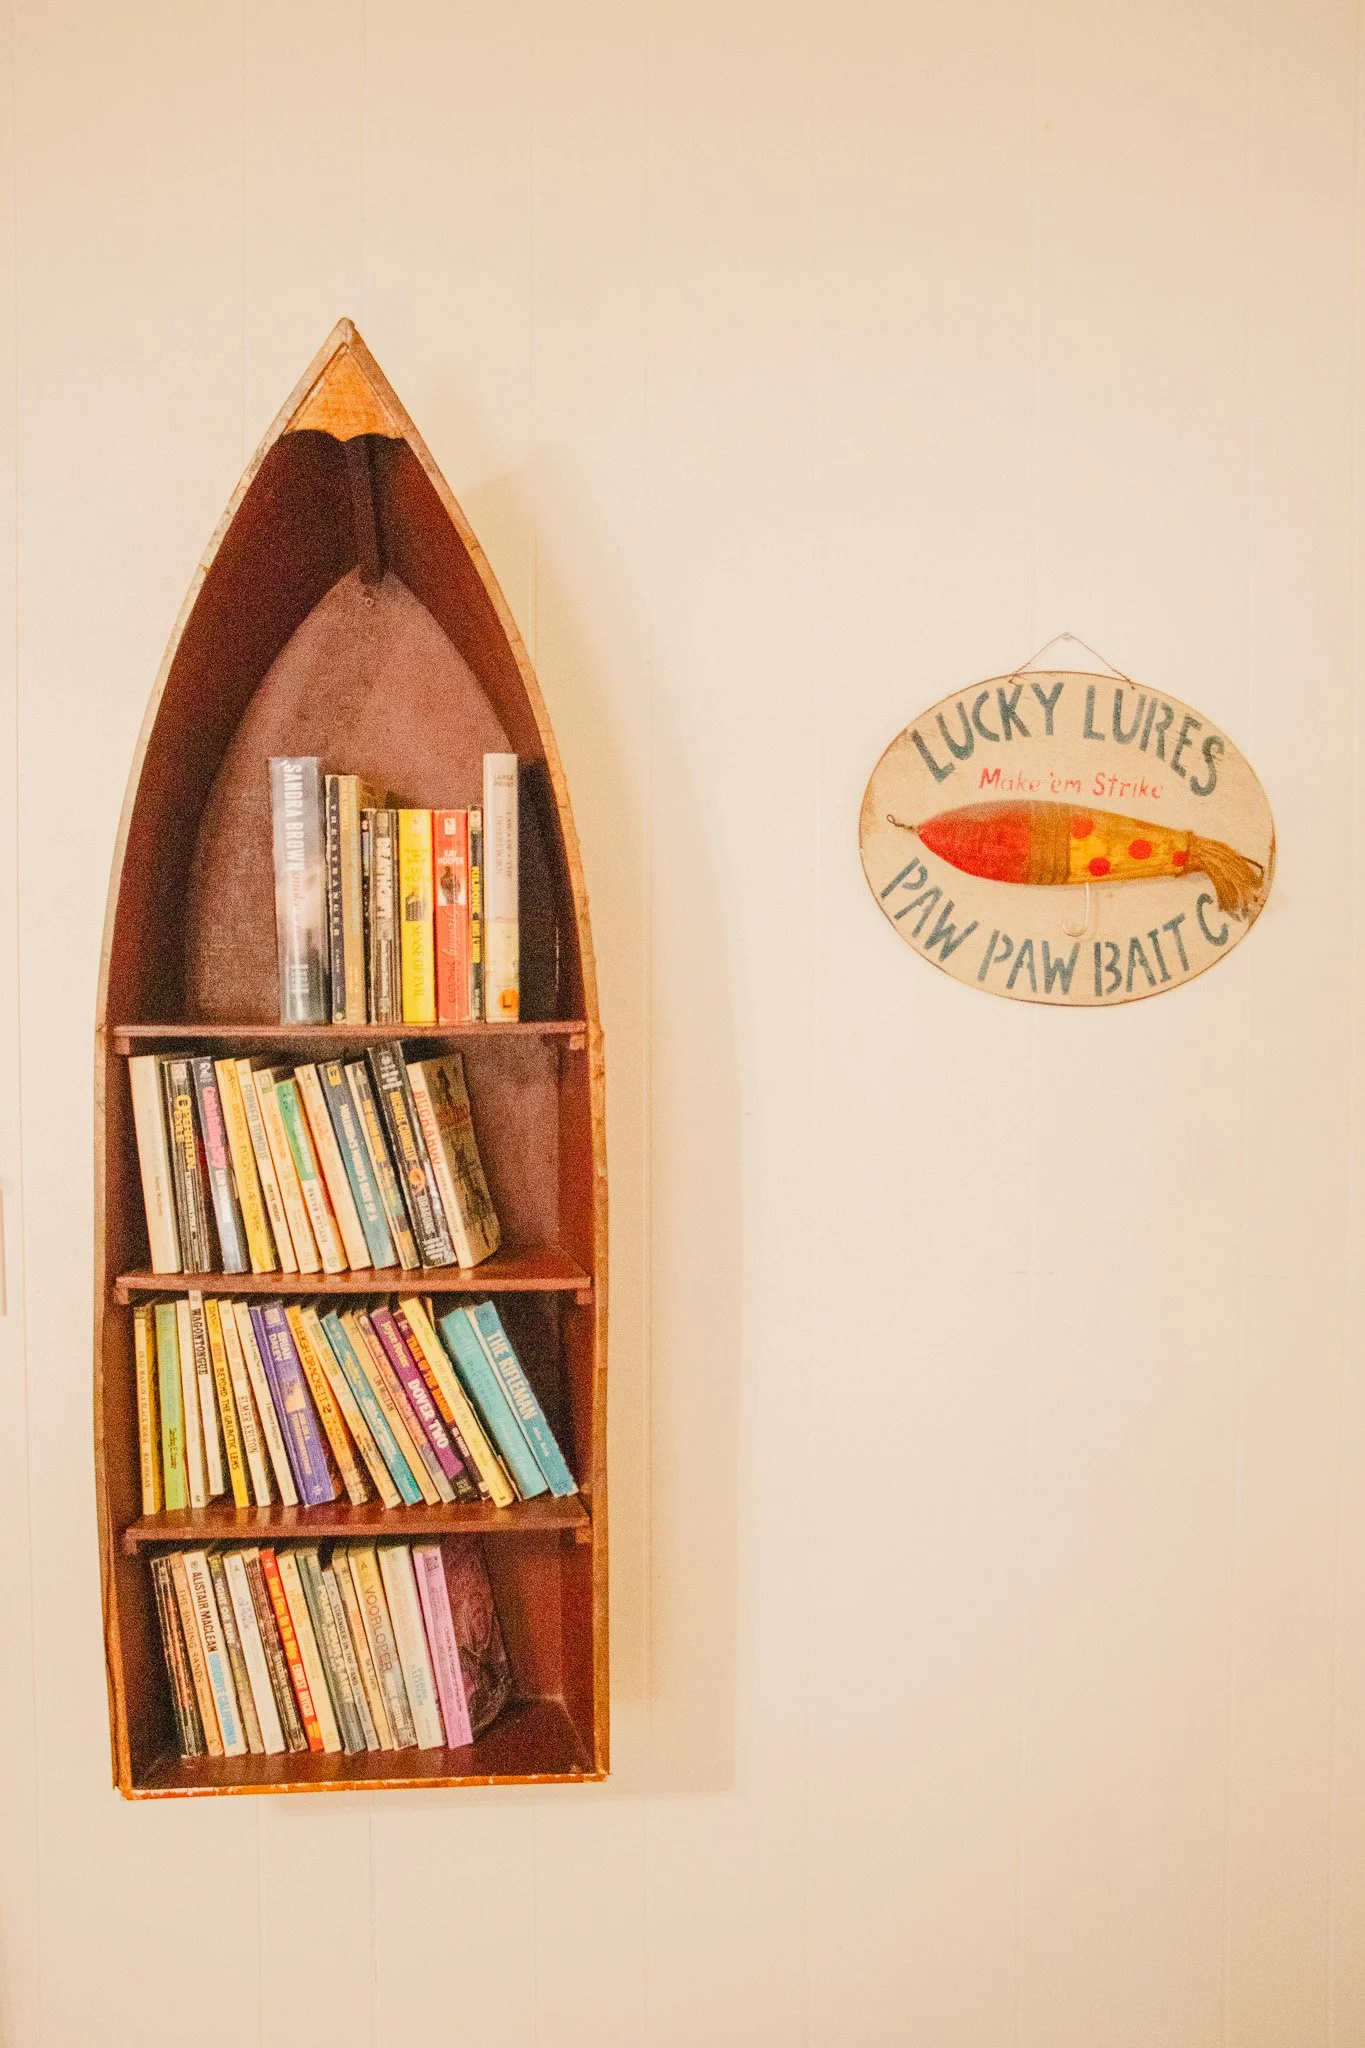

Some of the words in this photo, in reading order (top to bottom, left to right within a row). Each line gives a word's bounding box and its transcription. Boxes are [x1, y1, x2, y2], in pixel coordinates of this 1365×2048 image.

[911, 682, 1064, 784] LUCKY
[1083, 685, 1225, 796] LURES
[283, 764, 302, 817] SANDRA
[979, 767, 1040, 792] Make
[1048, 771, 1080, 794] 'em
[1092, 772, 1164, 799] Strike
[285, 821, 304, 870] BROWN
[412, 924, 424, 956] SENSE
[880, 857, 978, 962] PAW
[977, 929, 1080, 995] PAW
[1093, 912, 1191, 997] BAIT
[412, 975, 425, 998] EVIL
[175, 1094, 198, 1169] OPERATION
[413, 1089, 443, 1166] BUCKAROO
[416, 1195, 434, 1234] DRAGONS
[268, 1333, 282, 1362] DALEY
[276, 1330, 292, 1360] BRIAN
[380, 1320, 398, 1344] Joyce
[392, 1341, 410, 1368] Porter
[405, 1335, 424, 1361] TRAIL
[485, 1329, 510, 1358] THE
[216, 1367, 228, 1397] BEYOND
[294, 1325, 311, 1354] LEIGH
[303, 1353, 328, 1403] BRACKETT
[320, 1402, 332, 1414] 2
[416, 1359, 429, 1372] OF
[422, 1370, 437, 1389] THE
[221, 1399, 230, 1412] THE
[430, 1387, 454, 1424] DAMNED
[497, 1355, 538, 1421] RIFLEMAN
[237, 1394, 251, 1422] ELMER
[406, 1377, 435, 1423] DOVER
[427, 1418, 450, 1449] TWO
[223, 1414, 236, 1449] GALACTIC
[243, 1424, 257, 1454] KELTON
[229, 1451, 239, 1470] LENS
[177, 1588, 188, 1605] THE
[191, 1570, 209, 1609] ALISTAIR
[181, 1609, 197, 1649] SINGING
[199, 1609, 218, 1652] MACLEAN
[219, 1606, 230, 1622] OR
[332, 1603, 348, 1639] STRANGER
[363, 1584, 393, 1672] VOORLOPER
[223, 1622, 235, 1644] RUN
[190, 1652, 204, 1683] SANDS
[208, 1652, 227, 1694] GOODBYE
[217, 1694, 238, 1746] CALIFORNIA
